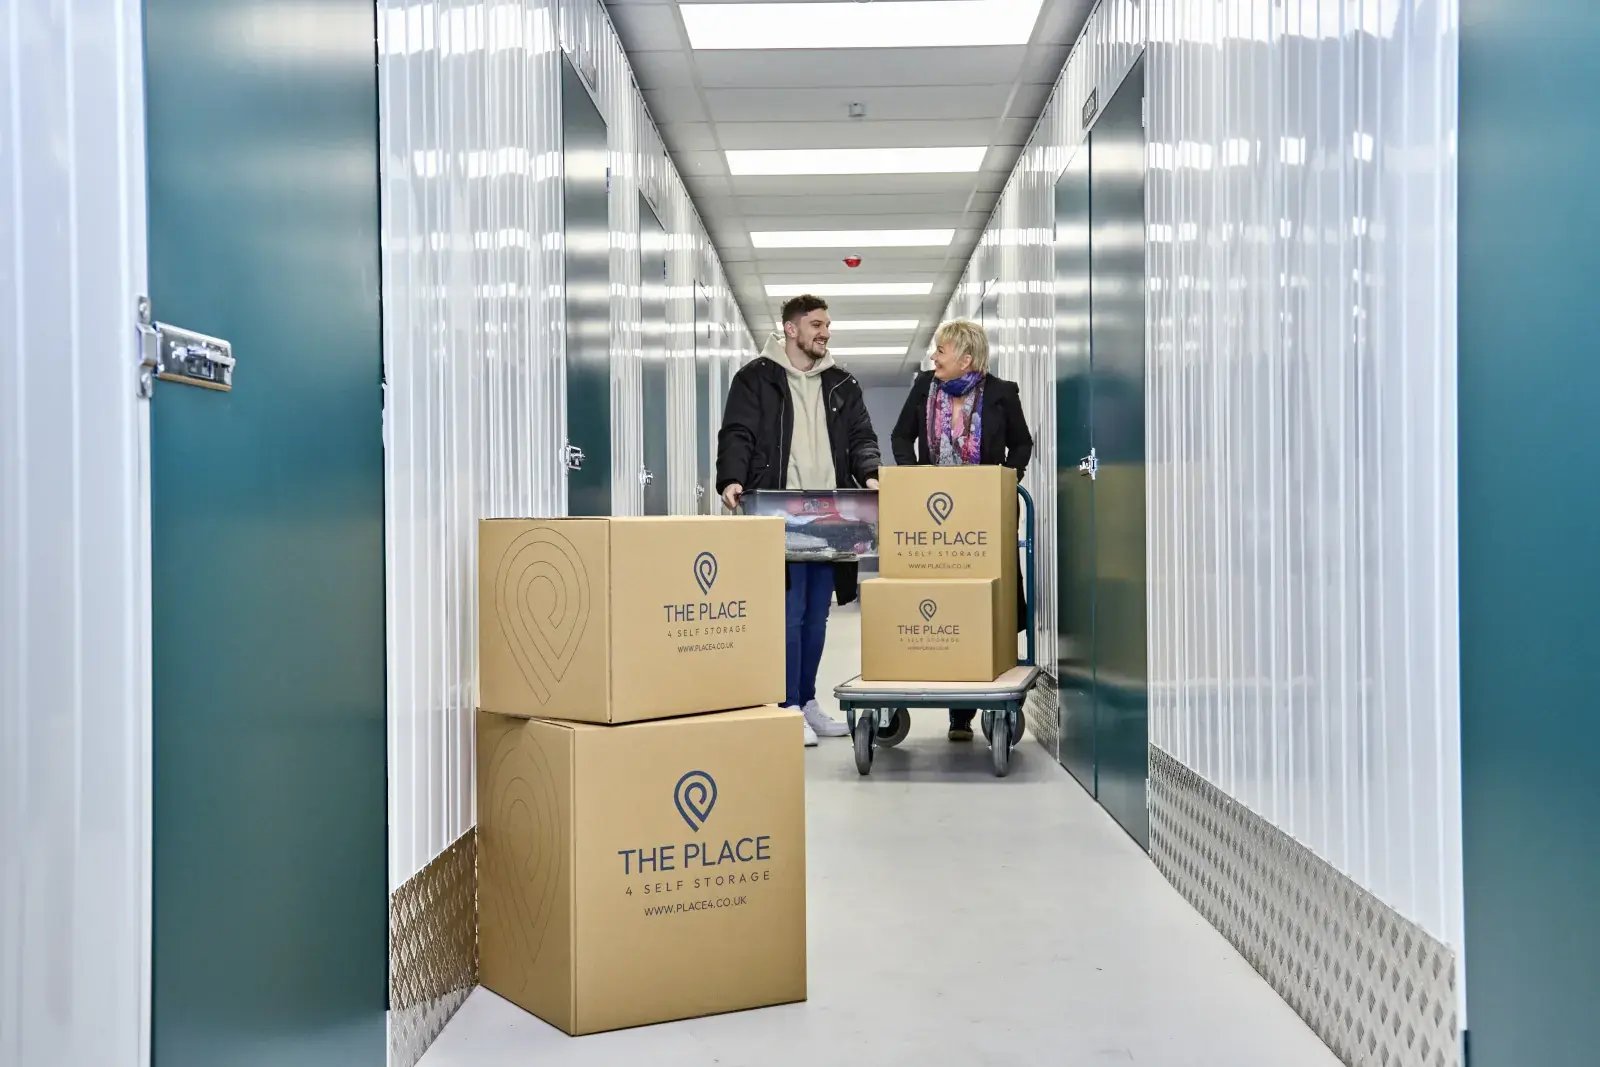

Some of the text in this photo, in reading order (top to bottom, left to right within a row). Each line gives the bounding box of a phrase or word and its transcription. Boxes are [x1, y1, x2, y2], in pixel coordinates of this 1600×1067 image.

[893, 531, 988, 546] THE PLACE
[663, 600, 747, 623] THE PLACE
[667, 624, 746, 638] 4 SELF STORAGE
[896, 624, 960, 635] THE PLACE
[677, 642, 734, 653] WWW.PLACE4.CO.UK
[617, 835, 771, 875] THE PLACE
[625, 870, 771, 896] 4 SELF STORAGE
[644, 895, 748, 917] WWW.PLACE4.CO.UK
